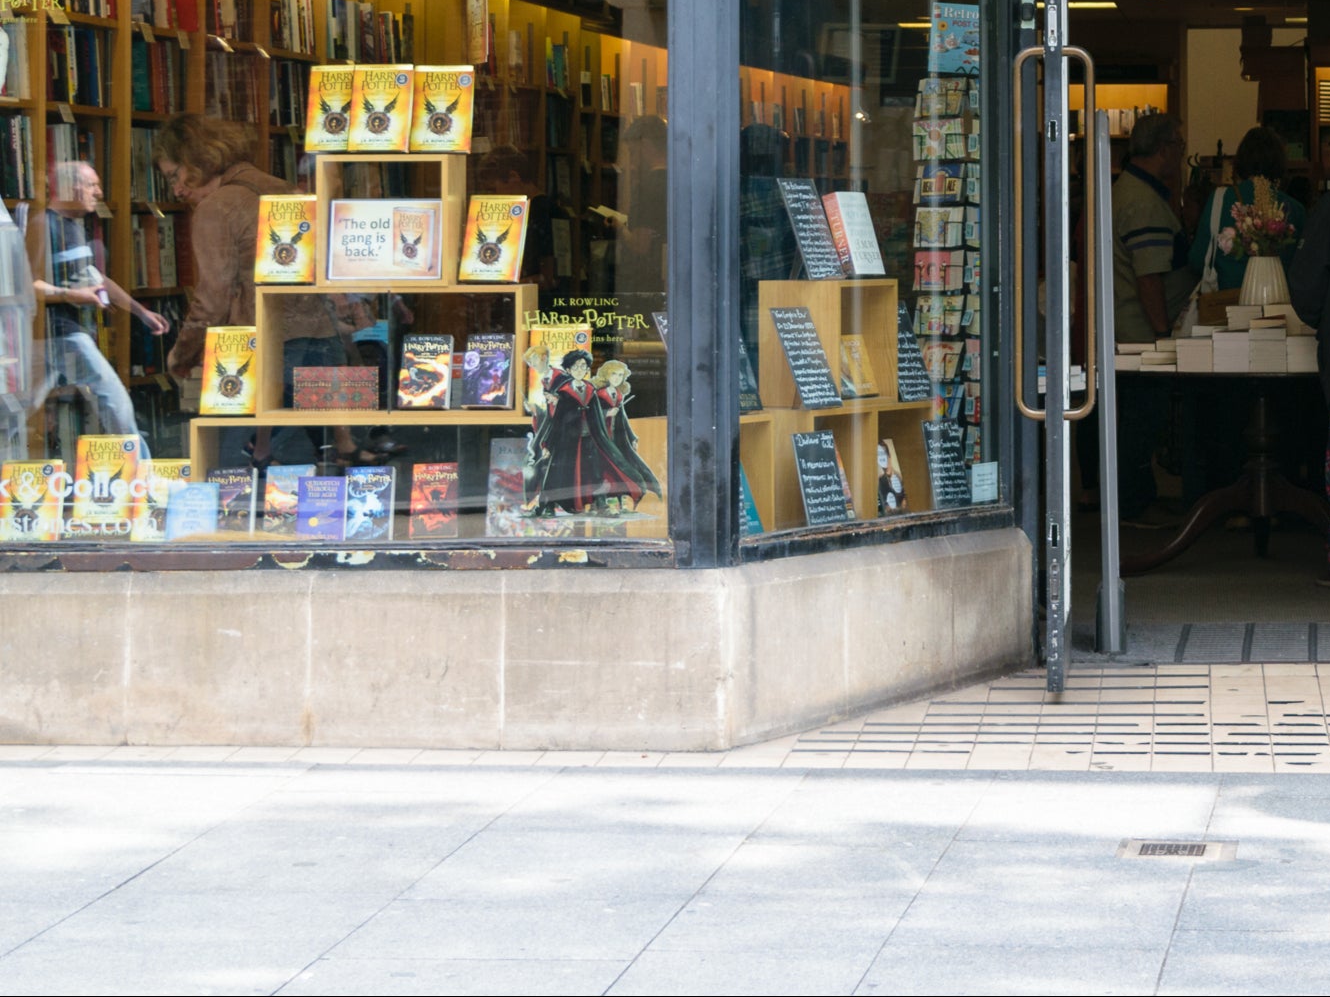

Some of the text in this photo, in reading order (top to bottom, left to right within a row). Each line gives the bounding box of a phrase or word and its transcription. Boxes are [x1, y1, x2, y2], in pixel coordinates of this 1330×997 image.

[943, 6, 980, 20] Retro
[322, 72, 354, 83] HARRY
[365, 71, 397, 81] HARRY
[426, 72, 460, 83] HARRY
[318, 81, 352, 91] POTTE
[362, 80, 400, 90] POTTER
[423, 81, 462, 91] POTTER
[271, 201, 305, 213] HARRY
[480, 202, 513, 213] HARRY
[267, 211, 308, 222] POTTER
[476, 211, 514, 222] POTTER
[370, 217, 390, 230] old
[341, 232, 386, 246] gang is
[345, 245, 382, 257] back.'
[570, 298, 619, 306] ROWLING
[583, 309, 650, 331] POTTER
[218, 333, 250, 344] HARRY
[606, 334, 624, 342] here
[214, 343, 254, 353] POTTER
[88, 441, 124, 452] HARRY
[86, 451, 126, 461] POTTER
[13, 466, 43, 477] HARR
[18, 472, 43, 498] &
